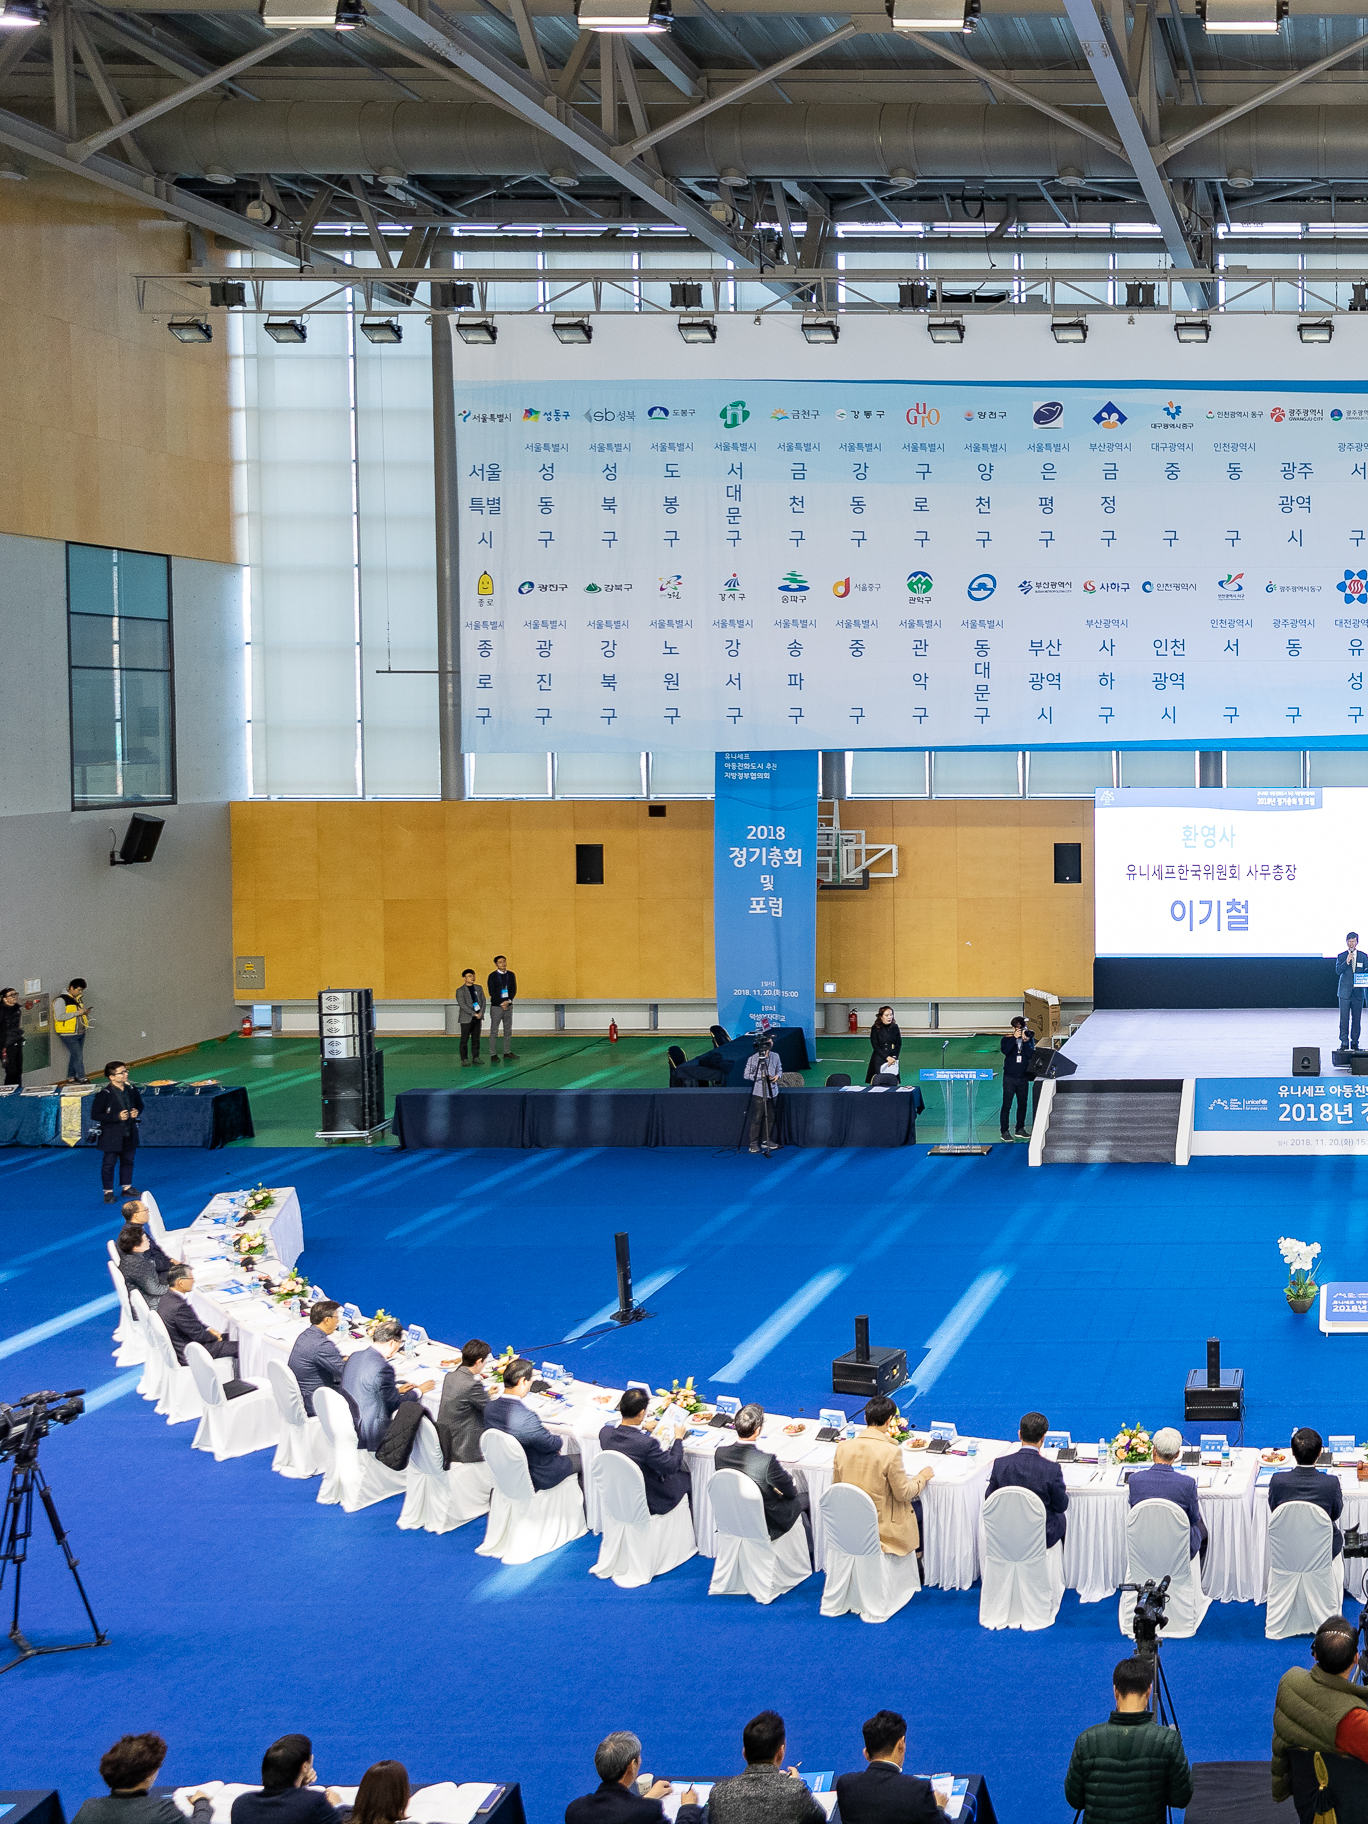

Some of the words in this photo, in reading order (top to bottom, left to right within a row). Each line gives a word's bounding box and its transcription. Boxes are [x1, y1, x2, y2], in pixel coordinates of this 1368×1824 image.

[470, 411, 511, 423] 서울특별시
[543, 409, 570, 422] 성동구
[617, 410, 636, 422] 성북
[791, 410, 820, 419] 금천구
[525, 443, 568, 452] 서울특별시
[651, 443, 693, 452] 서울특별시
[777, 442, 820, 452] 서울특별시
[902, 443, 944, 452] 서울특별시
[1027, 443, 1069, 452] 서울특별시
[1089, 443, 1131, 452] 부산광역시
[1151, 443, 1193, 452] 대구광역시
[1214, 443, 1255, 452] 인천광역시
[855, 583, 881, 591] 서울중구
[1100, 582, 1130, 592] 사하구
[782, 595, 806, 603] 송파구
[650, 619, 692, 629] 서울특별시
[724, 772, 770, 780] 지방정부협의회
[747, 825, 785, 840] 2018
[1182, 825, 1235, 848] 환영사
[729, 846, 801, 868] 정기총회
[1126, 864, 1239, 880] 유니세프한국위원회
[1247, 864, 1296, 880] 사무총장
[761, 875, 774, 891] 및
[749, 896, 782, 917] 포럼
[1171, 899, 1248, 931] 이기철
[1278, 1085, 1327, 1097] 유니세프
[1279, 1102, 1353, 1126] 2018년
